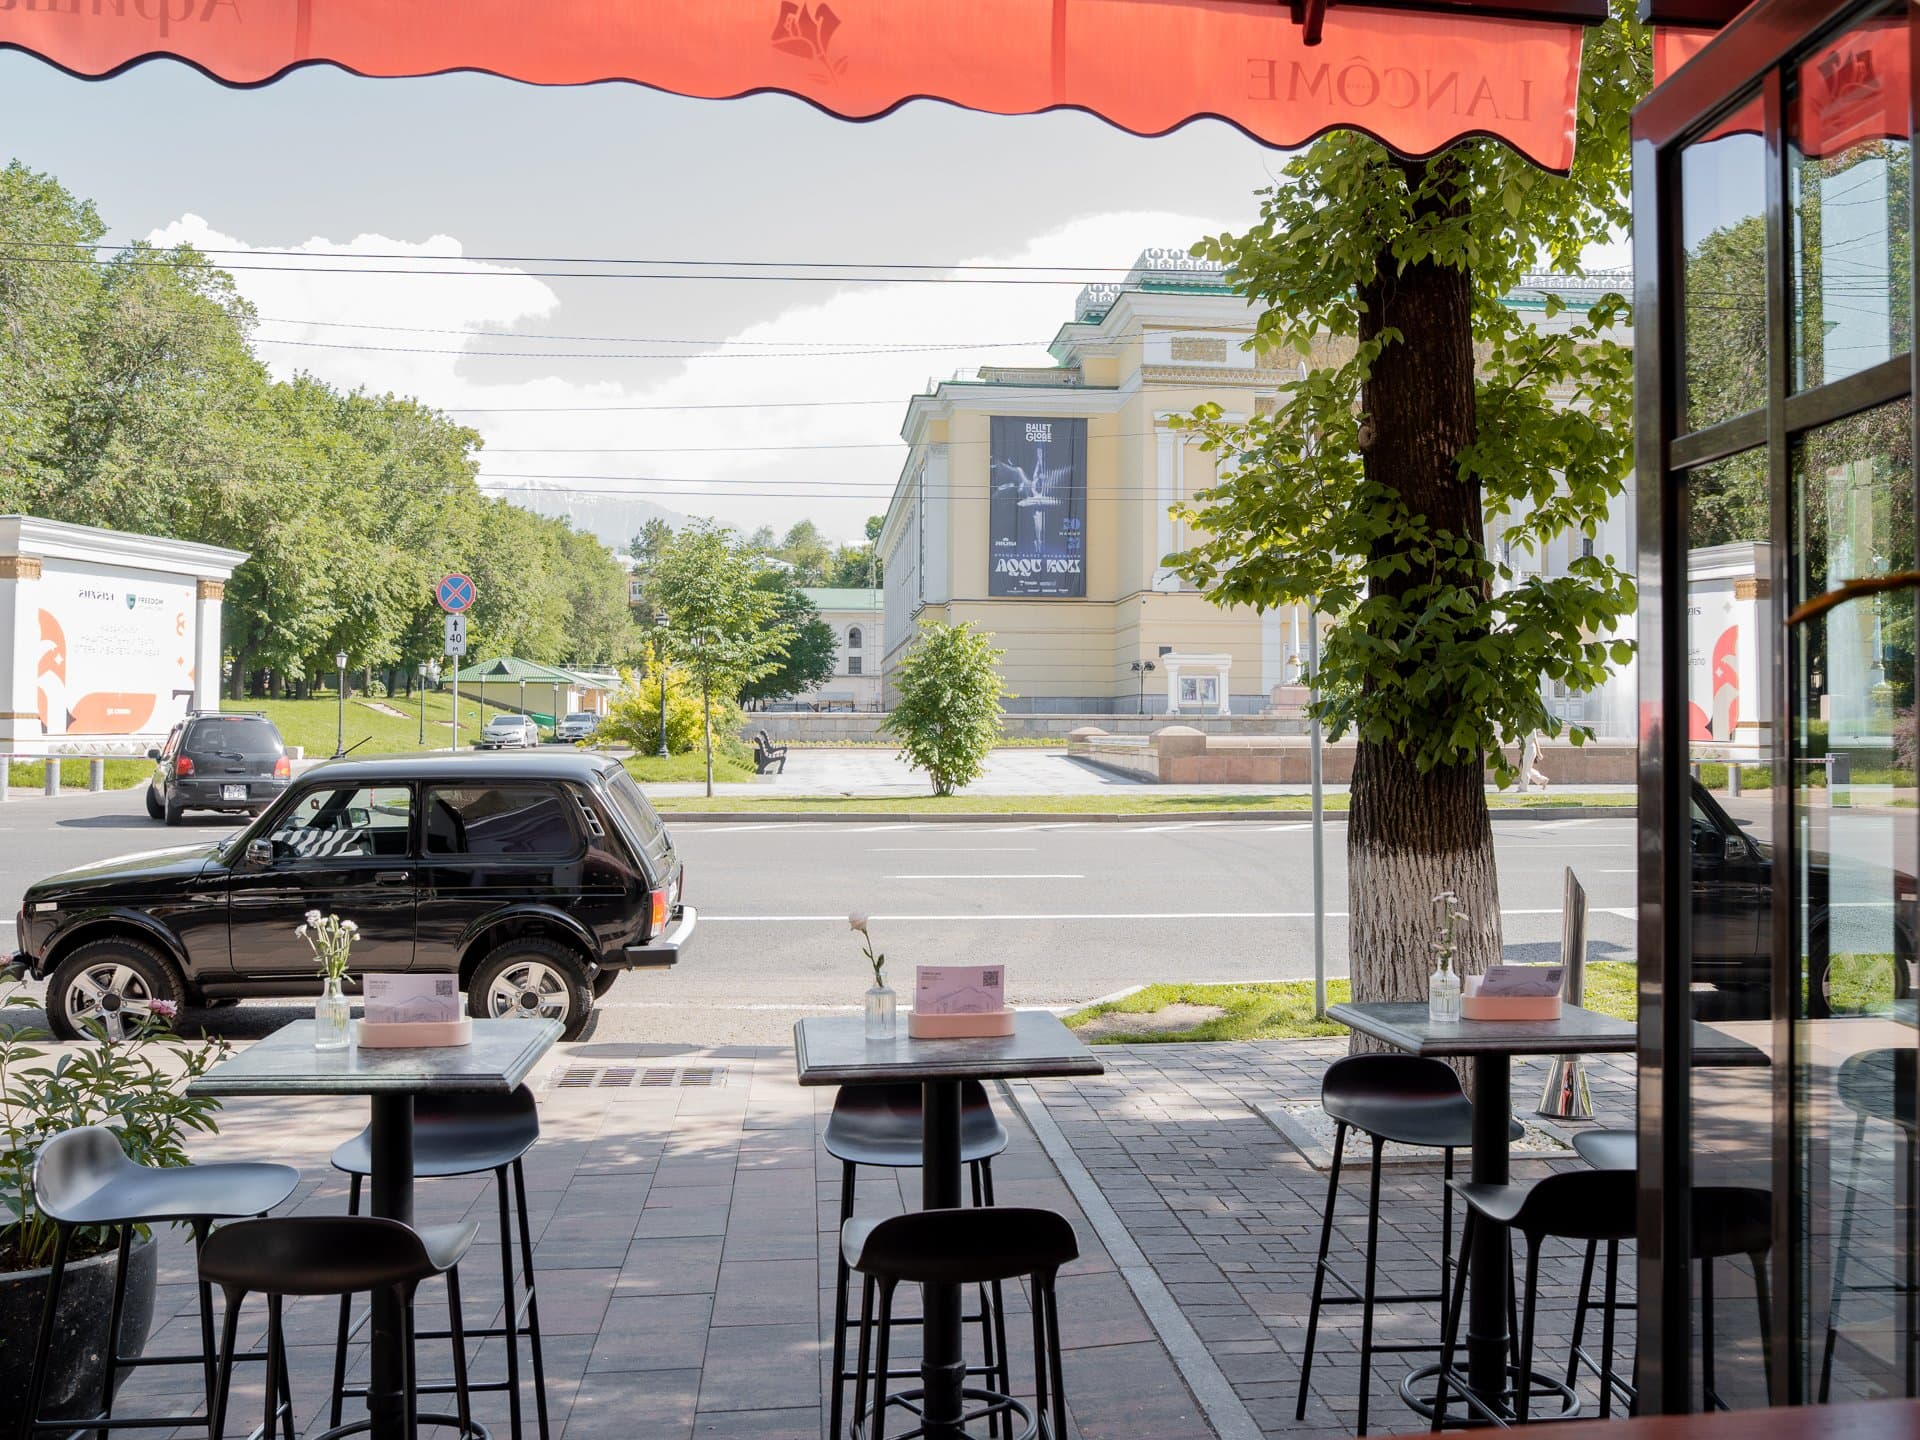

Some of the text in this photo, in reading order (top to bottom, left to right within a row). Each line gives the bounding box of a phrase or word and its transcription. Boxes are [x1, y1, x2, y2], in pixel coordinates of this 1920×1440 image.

[1025, 423, 1053, 433] BALLET
[1025, 433, 1052, 443] GLOBE
[138, 596, 164, 605] FREEDOM
[449, 633, 462, 643] 40
